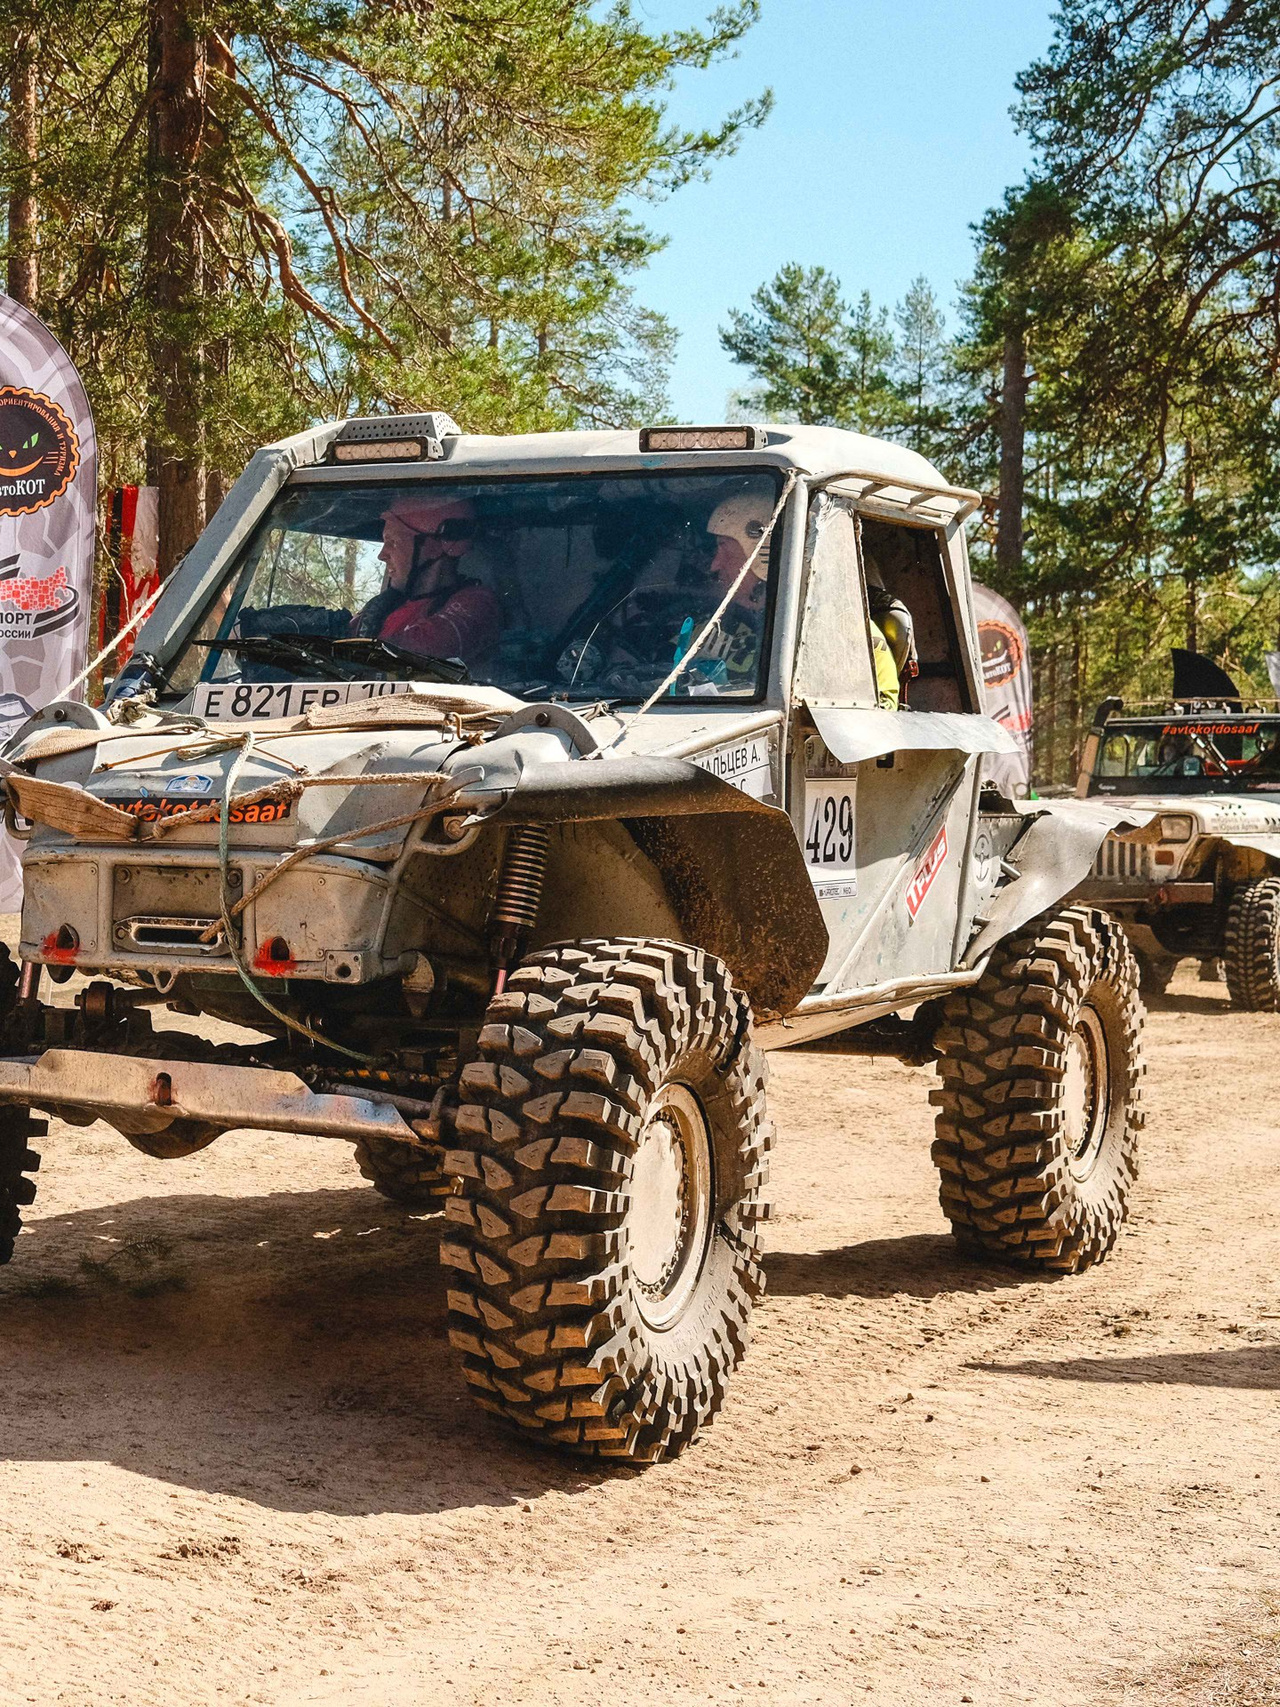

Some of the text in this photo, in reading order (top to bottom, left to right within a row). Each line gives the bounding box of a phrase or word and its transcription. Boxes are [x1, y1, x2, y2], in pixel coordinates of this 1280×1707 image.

[54, 441, 67, 476] ТУРИЗМА
[1162, 723, 1261, 736] #avtokotdosaaf
[701, 747, 747, 776] АЛЬЦЕВ
[806, 795, 853, 863] 429
[906, 836, 947, 908] TPLUS
